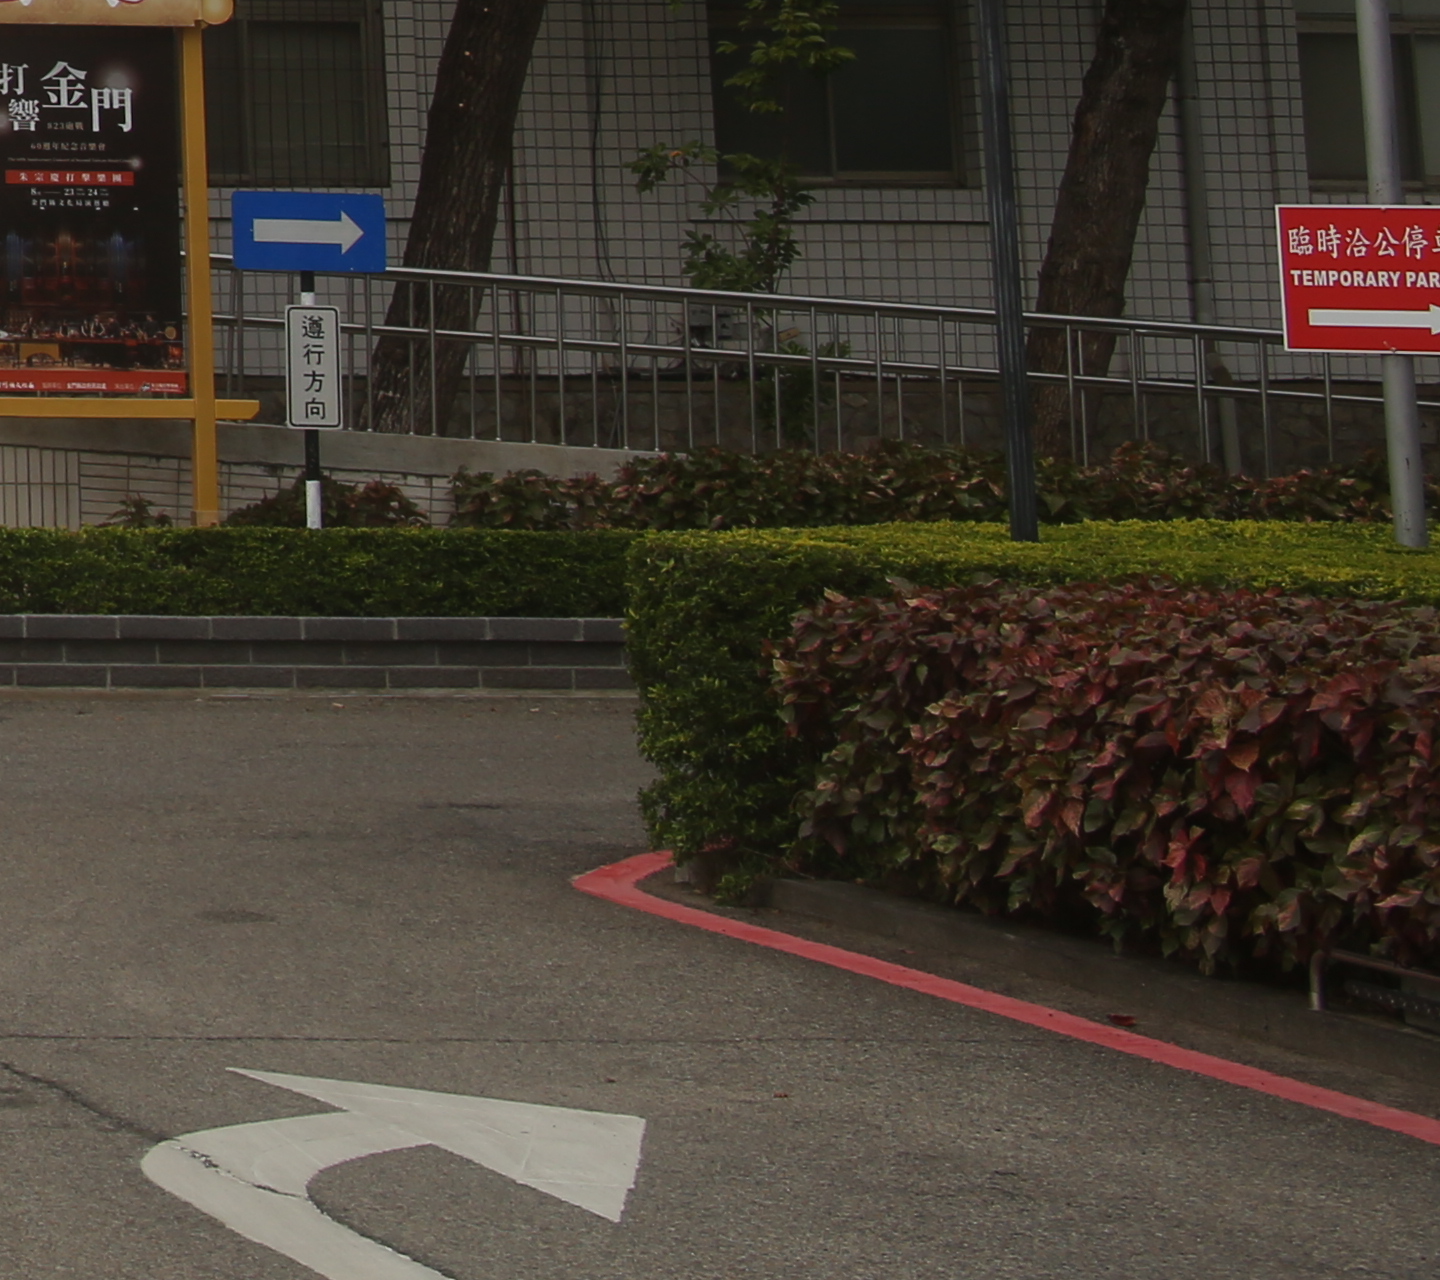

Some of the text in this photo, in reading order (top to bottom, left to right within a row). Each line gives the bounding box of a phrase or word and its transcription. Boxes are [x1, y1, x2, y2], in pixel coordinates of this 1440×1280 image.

[1289, 270, 1401, 288] TEMPORARY
[302, 316, 326, 419] 遵行方向
